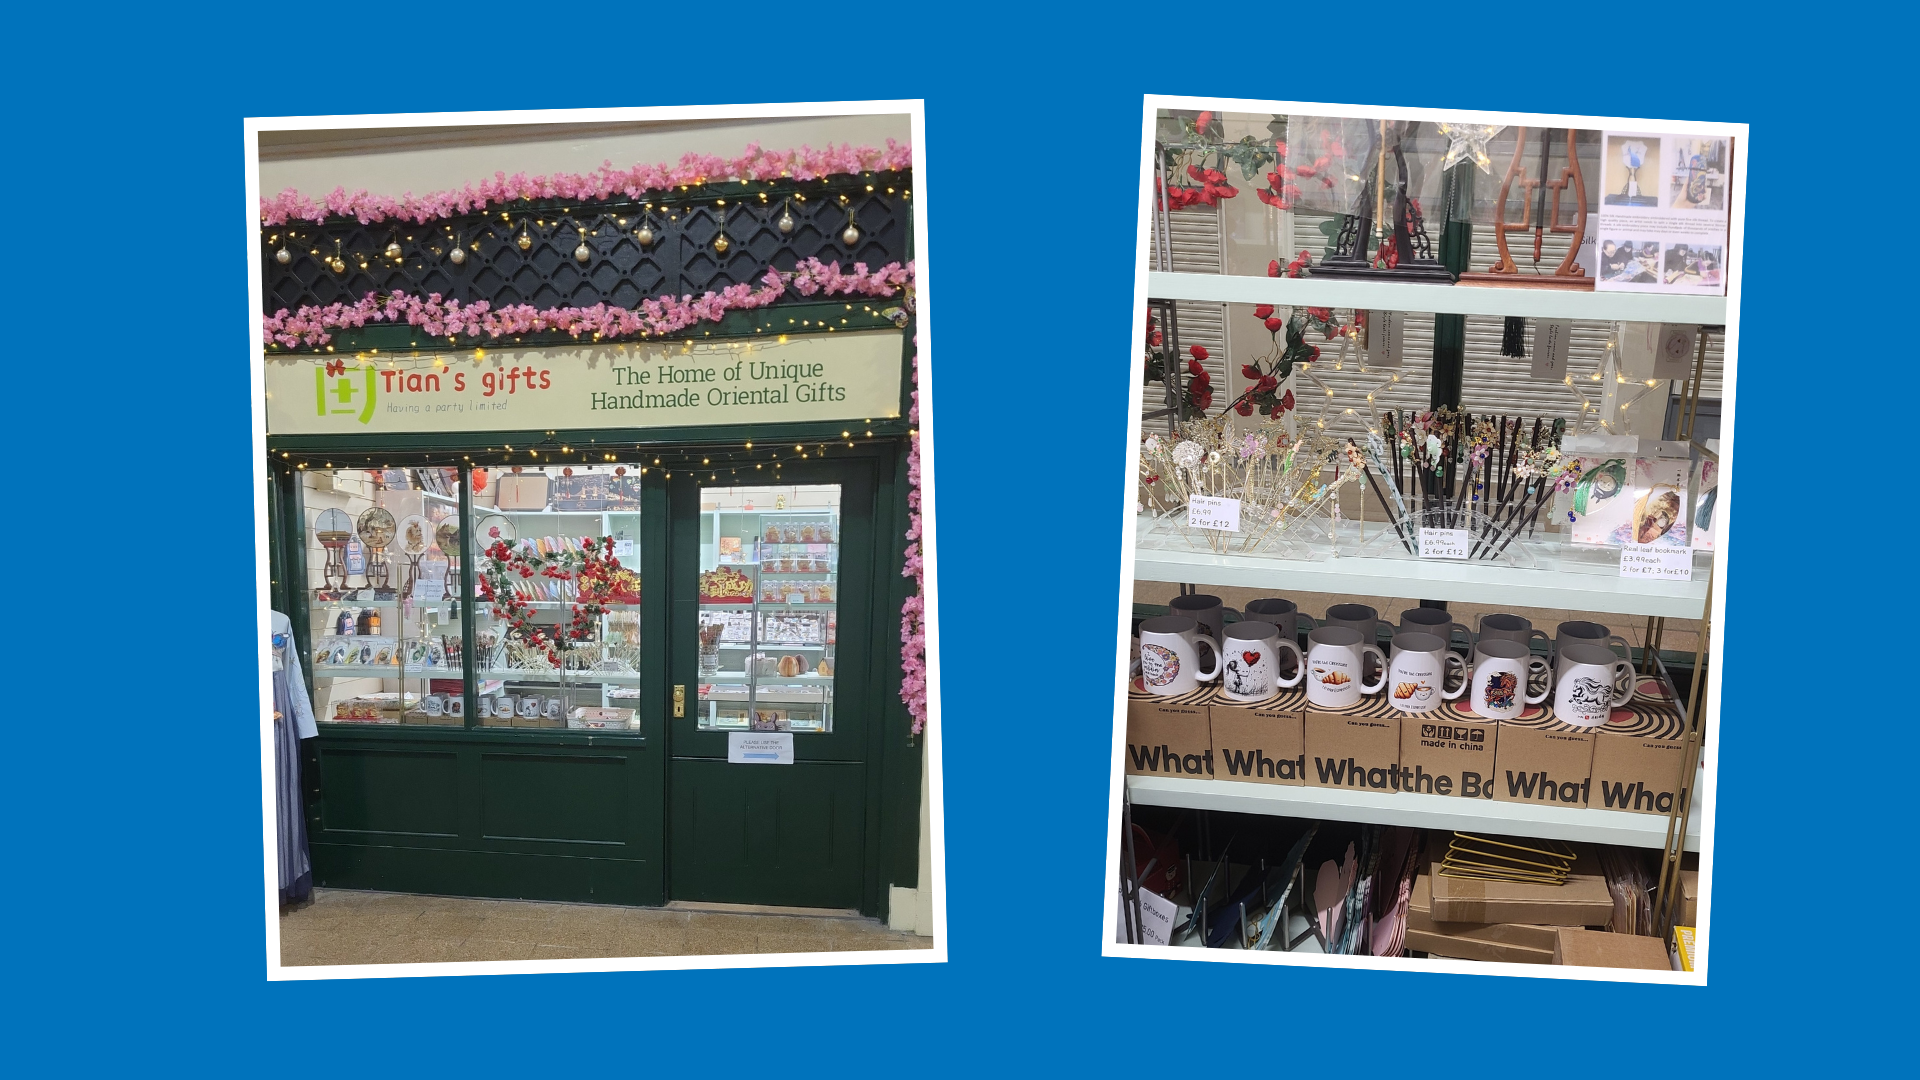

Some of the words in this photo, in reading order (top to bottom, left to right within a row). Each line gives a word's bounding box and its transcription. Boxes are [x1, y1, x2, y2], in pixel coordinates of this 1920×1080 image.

[380, 366, 465, 392] Tian's
[482, 366, 551, 396] gifts
[612, 366, 650, 386] The
[658, 365, 716, 384] Home
[723, 361, 743, 382] of
[749, 359, 824, 383] Unique
[386, 401, 419, 414] Having
[425, 405, 431, 413] a
[435, 402, 464, 413] party
[469, 399, 508, 411] limited
[591, 388, 700, 411] Handmade
[707, 384, 789, 407] Oriental
[796, 382, 846, 403] Gifts
[1213, 520, 1230, 528] £12
[1446, 548, 1463, 556] £12
[1655, 547, 1686, 555] bookmark
[1421, 739, 1446, 748] made
[1448, 741, 1456, 749] in
[1460, 742, 1483, 751] china
[1128, 744, 1214, 775] What
[1222, 749, 1305, 780] What
[1314, 757, 1400, 790] What
[1400, 765, 1453, 795] the
[1143, 902, 1169, 923] Giftboxes
